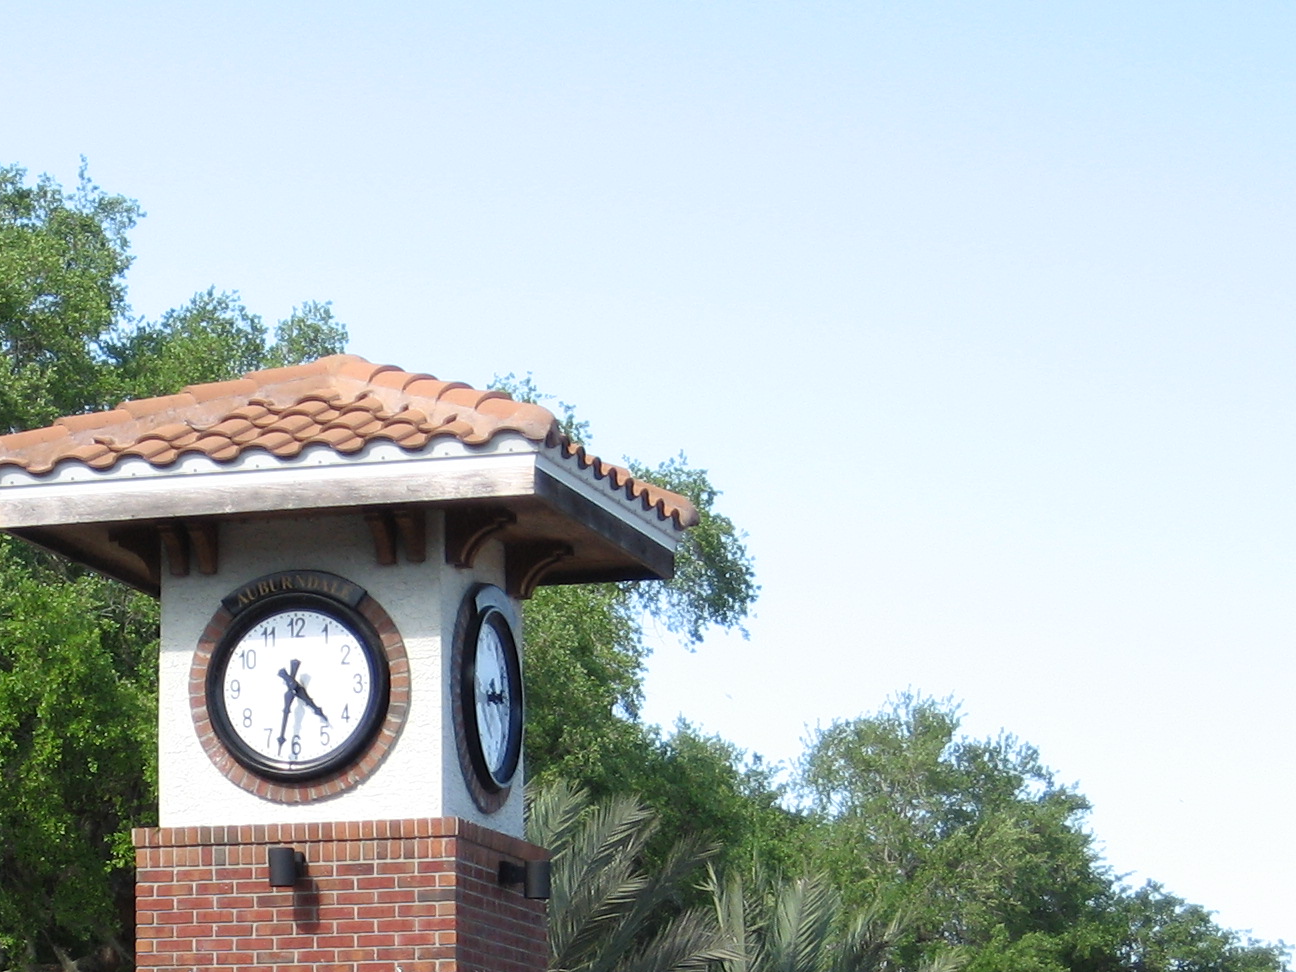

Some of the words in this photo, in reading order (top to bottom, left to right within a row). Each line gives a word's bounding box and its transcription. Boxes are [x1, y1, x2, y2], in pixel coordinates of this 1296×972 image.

[237, 575, 354, 607] AUBURNDALE
[260, 626, 276, 647] 11
[287, 617, 306, 638] 12
[321, 624, 329, 644] 1
[239, 649, 256, 670] 10
[340, 644, 351, 665] 2
[230, 679, 241, 699] 9
[353, 673, 364, 694] 3
[242, 708, 253, 728] 8
[340, 703, 351, 723] 4
[263, 727, 273, 749] 7
[291, 735, 302, 755] 6
[319, 725, 330, 746] 5
